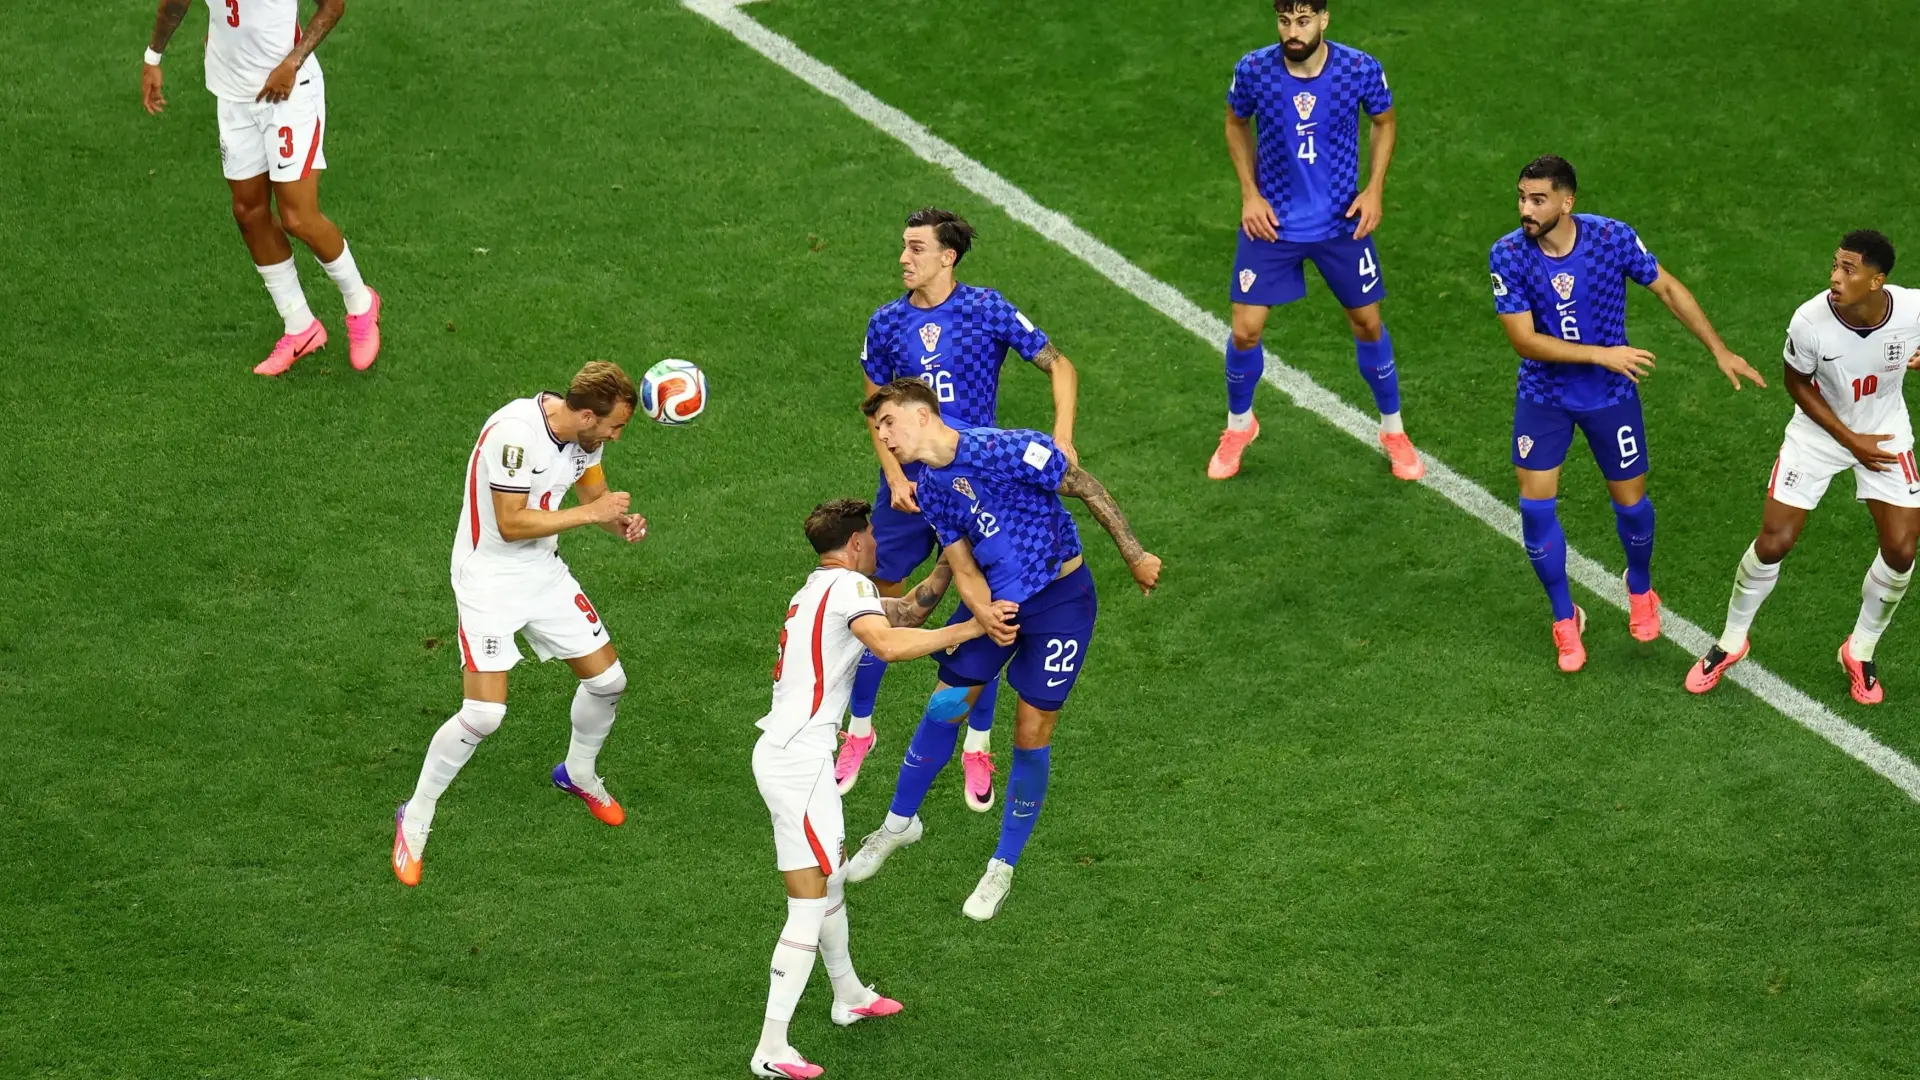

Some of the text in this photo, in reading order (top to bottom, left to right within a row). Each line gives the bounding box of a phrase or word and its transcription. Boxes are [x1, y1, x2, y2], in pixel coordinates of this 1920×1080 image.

[225, 0, 240, 28] 3
[278, 126, 294, 158] 3
[1297, 135, 1318, 165] 4
[1358, 247, 1377, 278] 4
[1560, 316, 1581, 341] 6
[1851, 374, 1878, 403] 10
[1616, 425, 1638, 458] 6
[574, 593, 598, 624] 9
[1044, 638, 1078, 672] 22
